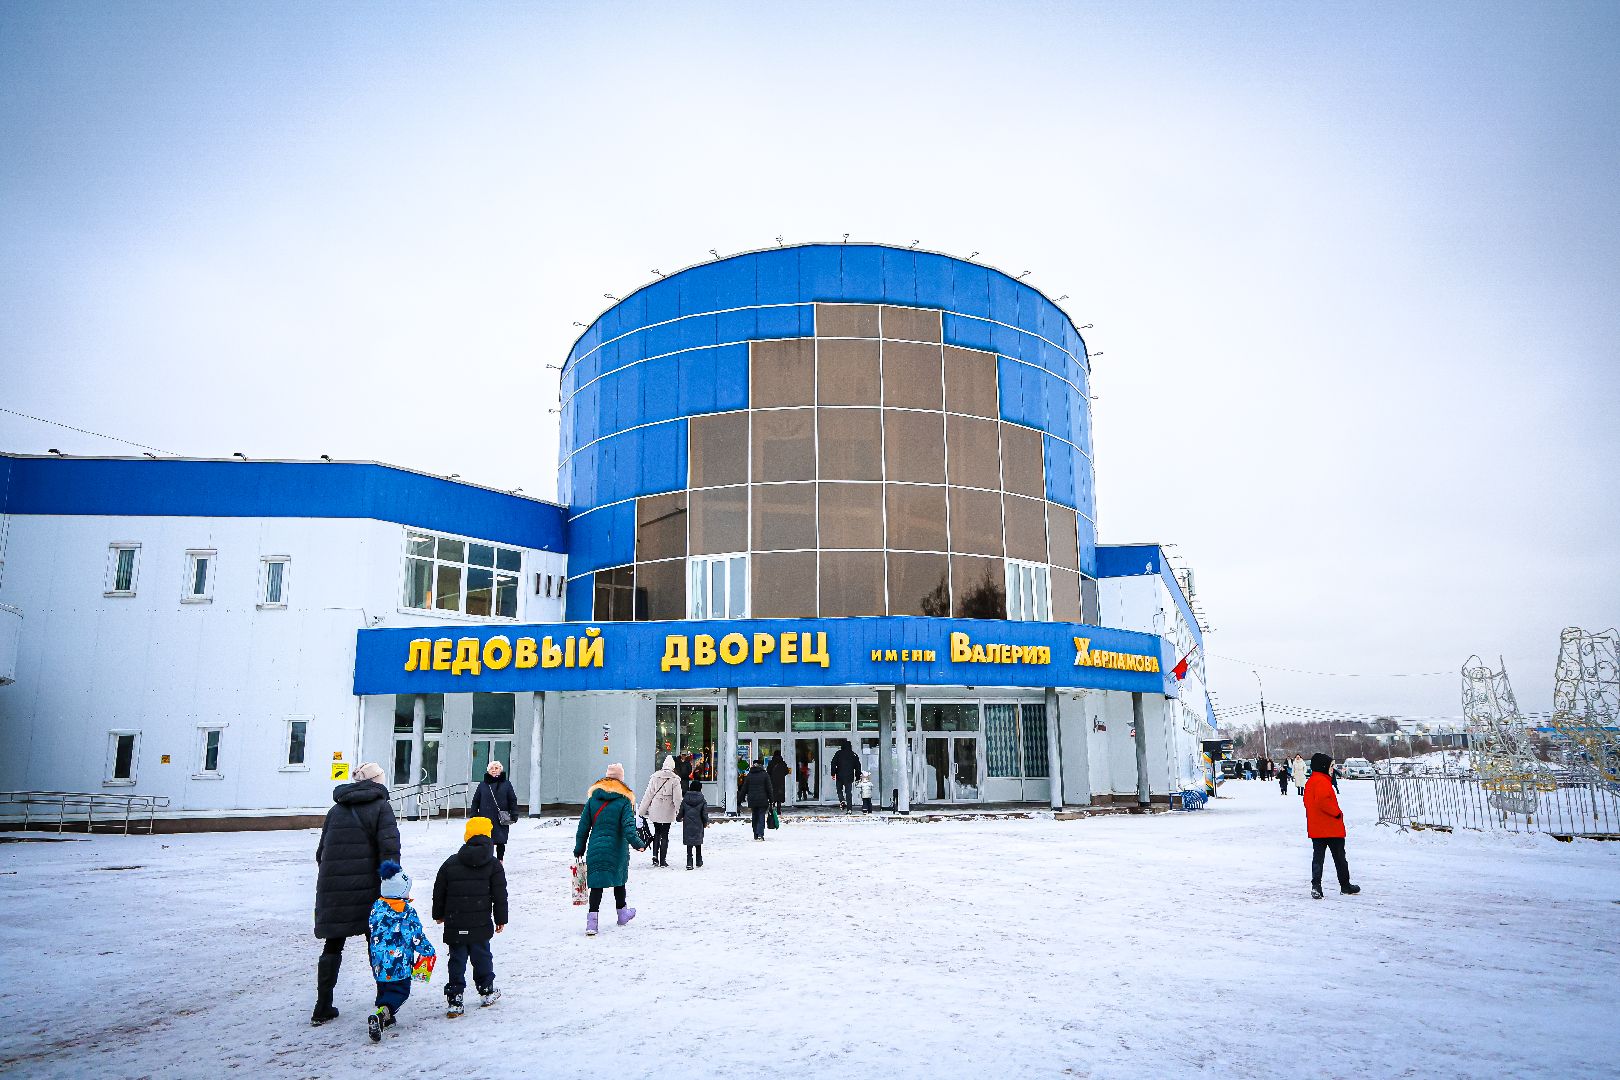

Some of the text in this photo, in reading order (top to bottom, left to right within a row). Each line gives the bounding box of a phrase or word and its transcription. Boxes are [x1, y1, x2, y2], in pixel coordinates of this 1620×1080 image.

[404, 627, 605, 676] ЛЕДОВЫЙ
[661, 632, 830, 672] ДВОРЕЦ
[871, 649, 936, 662] ИМЕНИ
[950, 632, 1051, 665] ВАЛЕРИЯ
